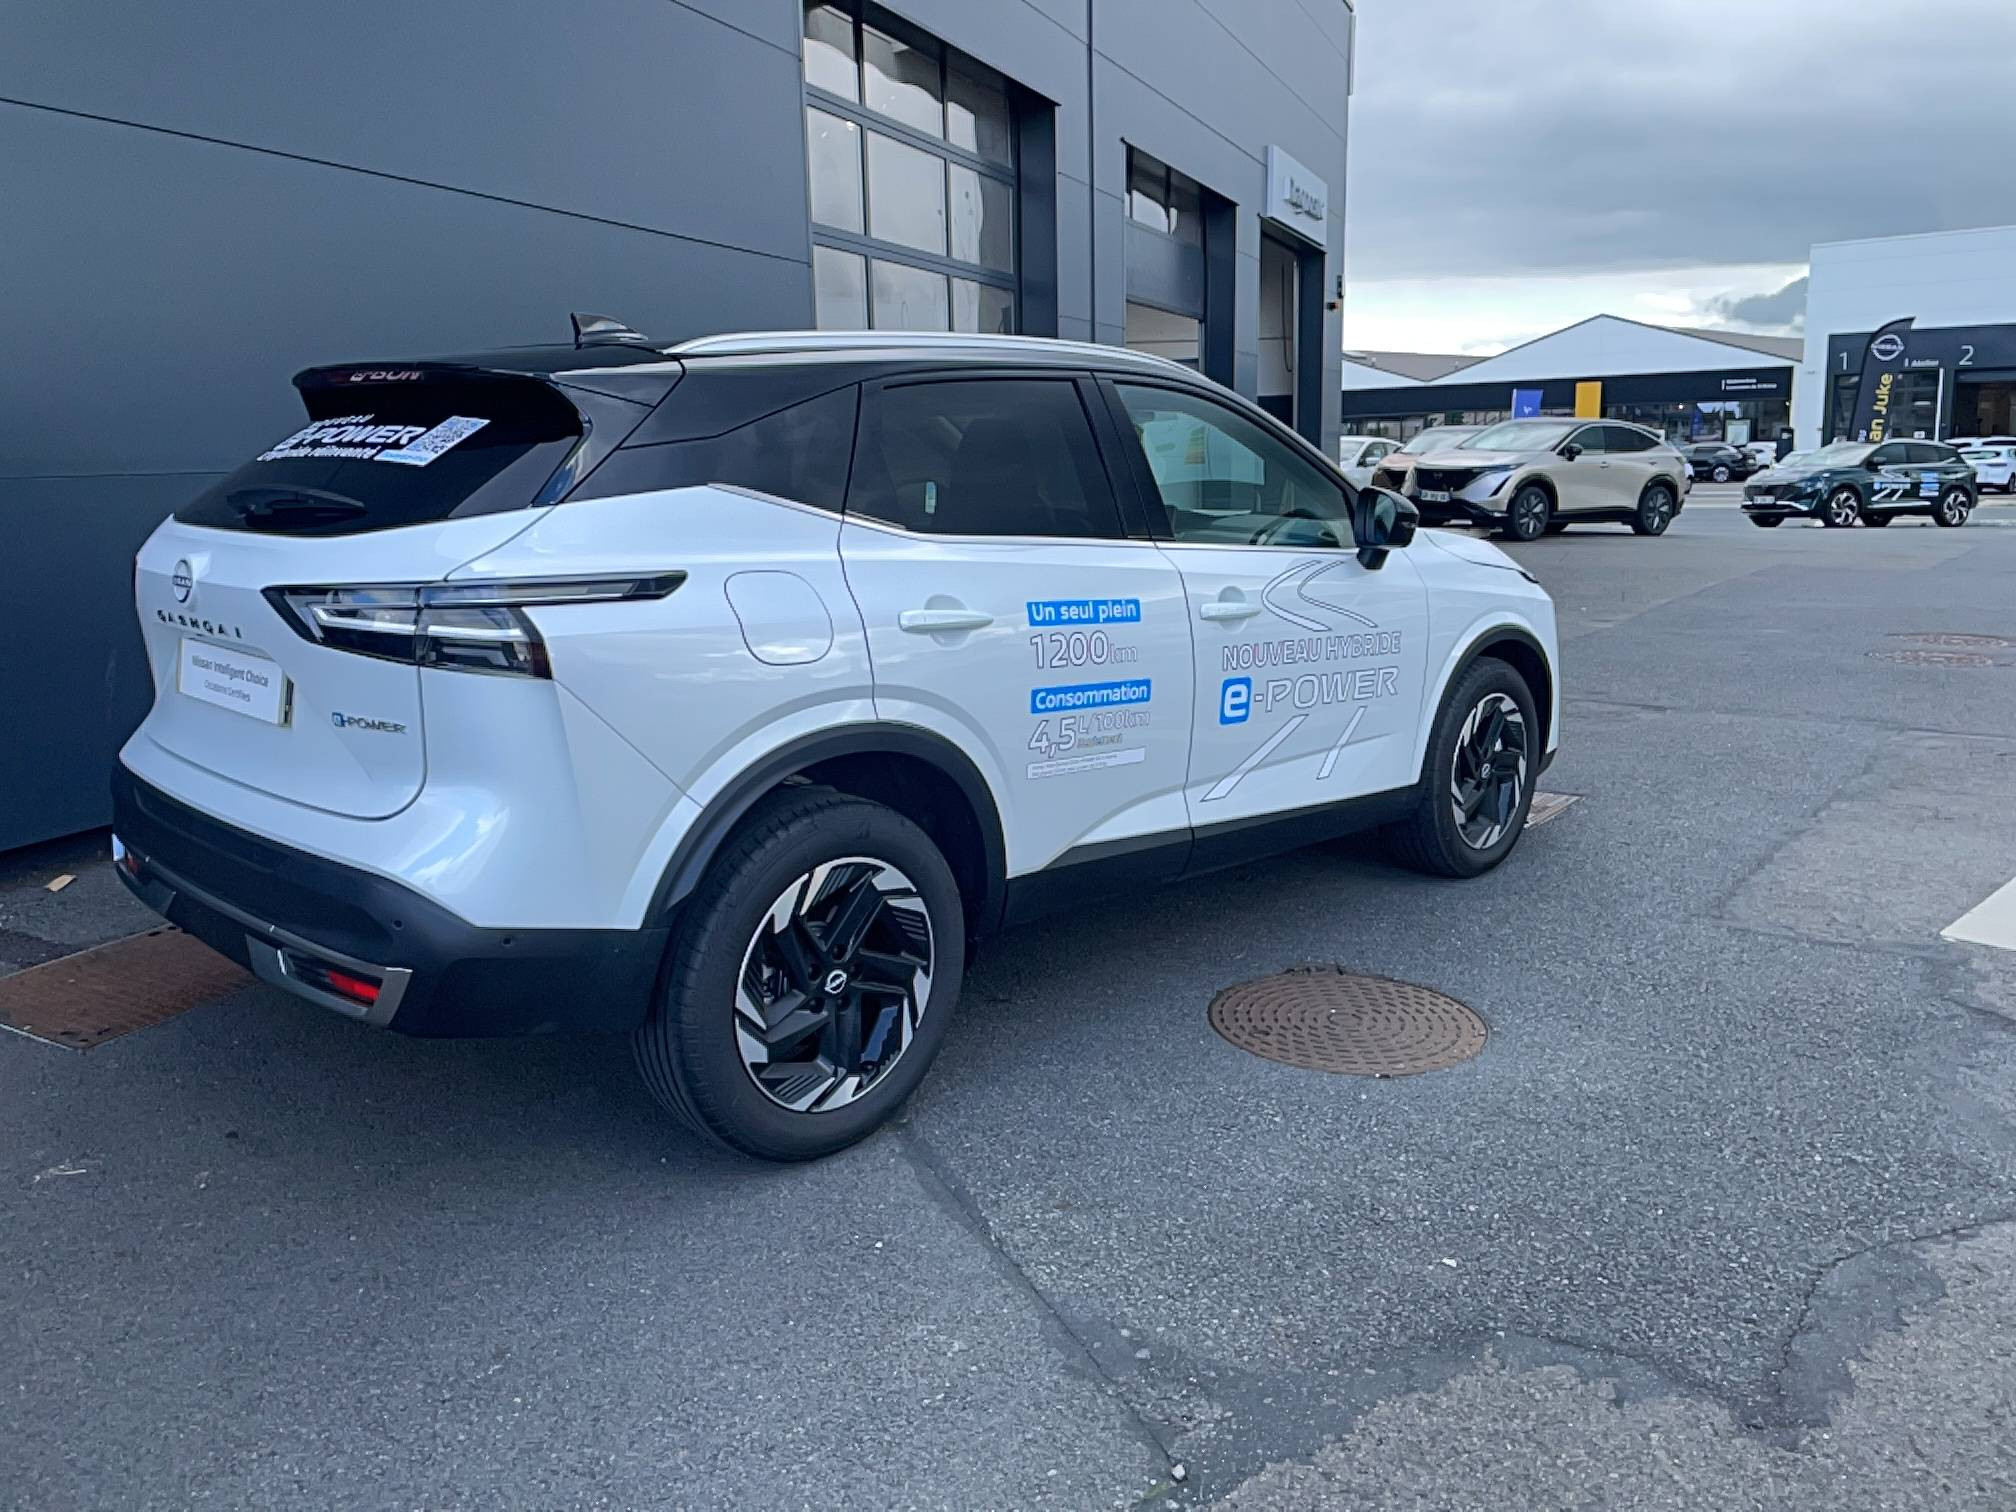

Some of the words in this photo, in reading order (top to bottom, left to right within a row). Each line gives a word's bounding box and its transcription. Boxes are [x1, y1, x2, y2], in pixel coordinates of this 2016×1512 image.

[1839, 352, 1848, 371] 1
[1959, 345, 1974, 366] 2
[1872, 373, 1893, 415] Juke
[1031, 603, 1056, 621] Un
[1060, 601, 1094, 620] seul
[1098, 599, 1137, 622] plein
[1222, 637, 1322, 671] NOUVEAU
[1325, 631, 1401, 661] HYBRIDE
[1035, 684, 1147, 710] Consommation
[1223, 665, 1400, 719] e-POWER
